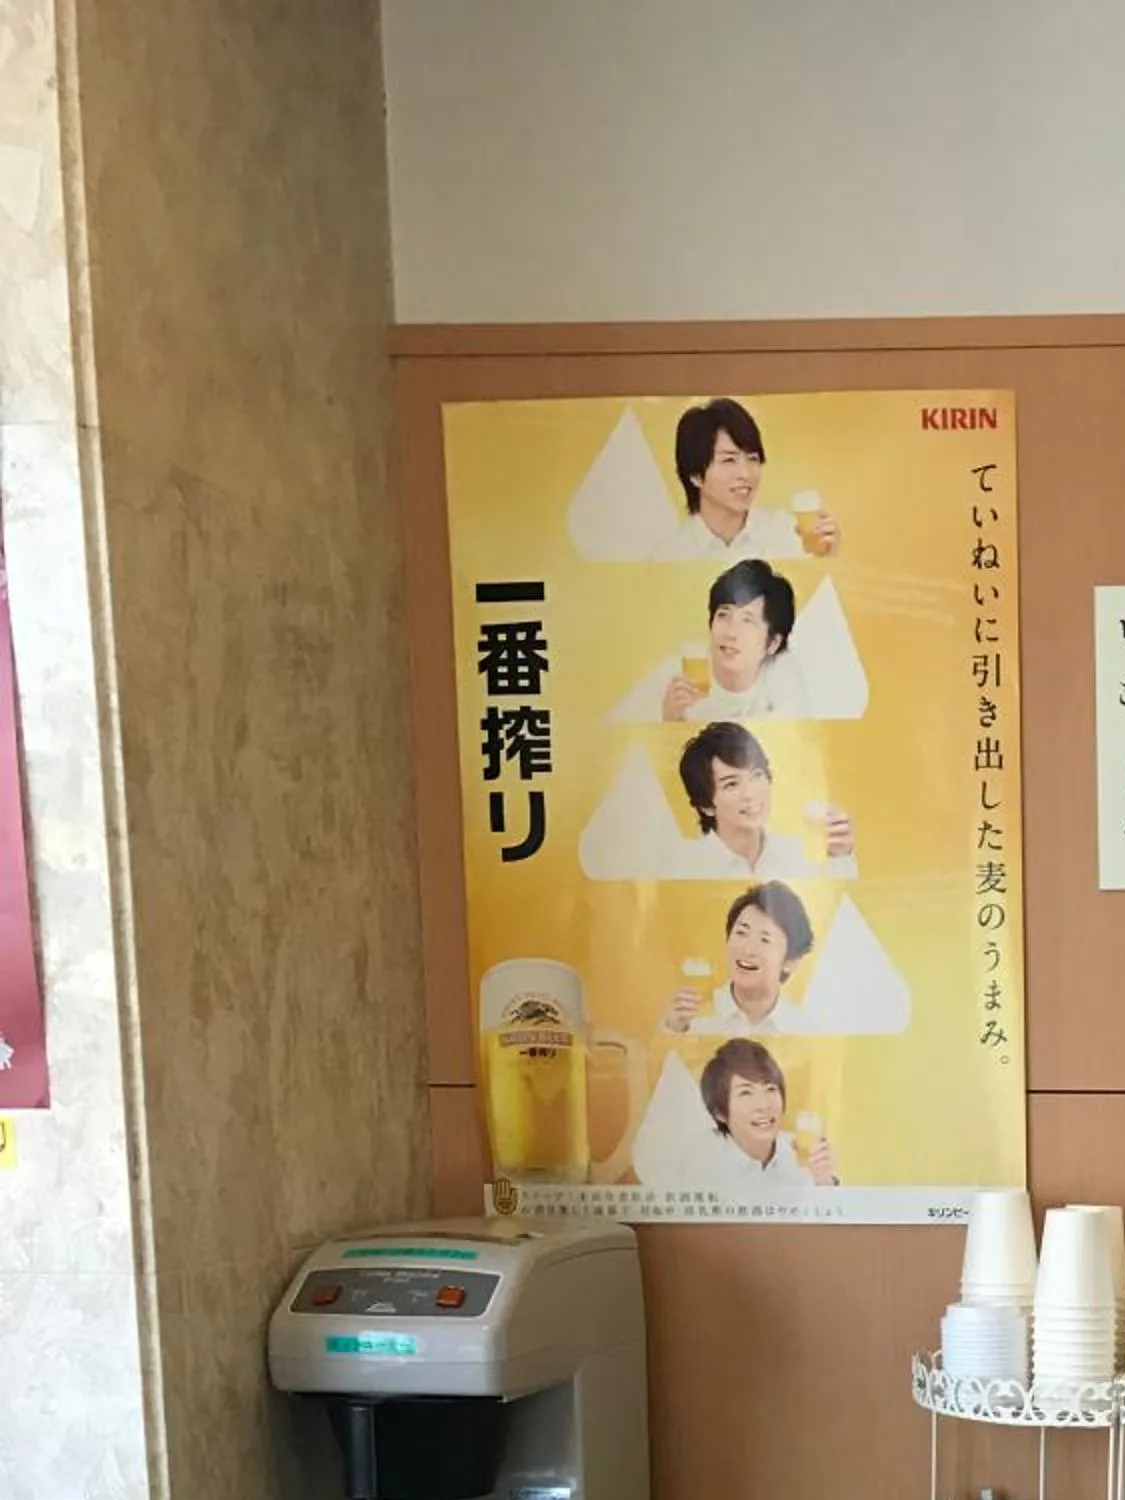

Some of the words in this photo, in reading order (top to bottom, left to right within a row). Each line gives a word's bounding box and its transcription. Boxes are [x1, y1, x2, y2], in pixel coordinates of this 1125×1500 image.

[921, 407, 998, 431] KIRIN
[475, 580, 553, 863] 一番搾り
[970, 463, 1011, 1065] ていねいに引き出した麦のうまみ。
